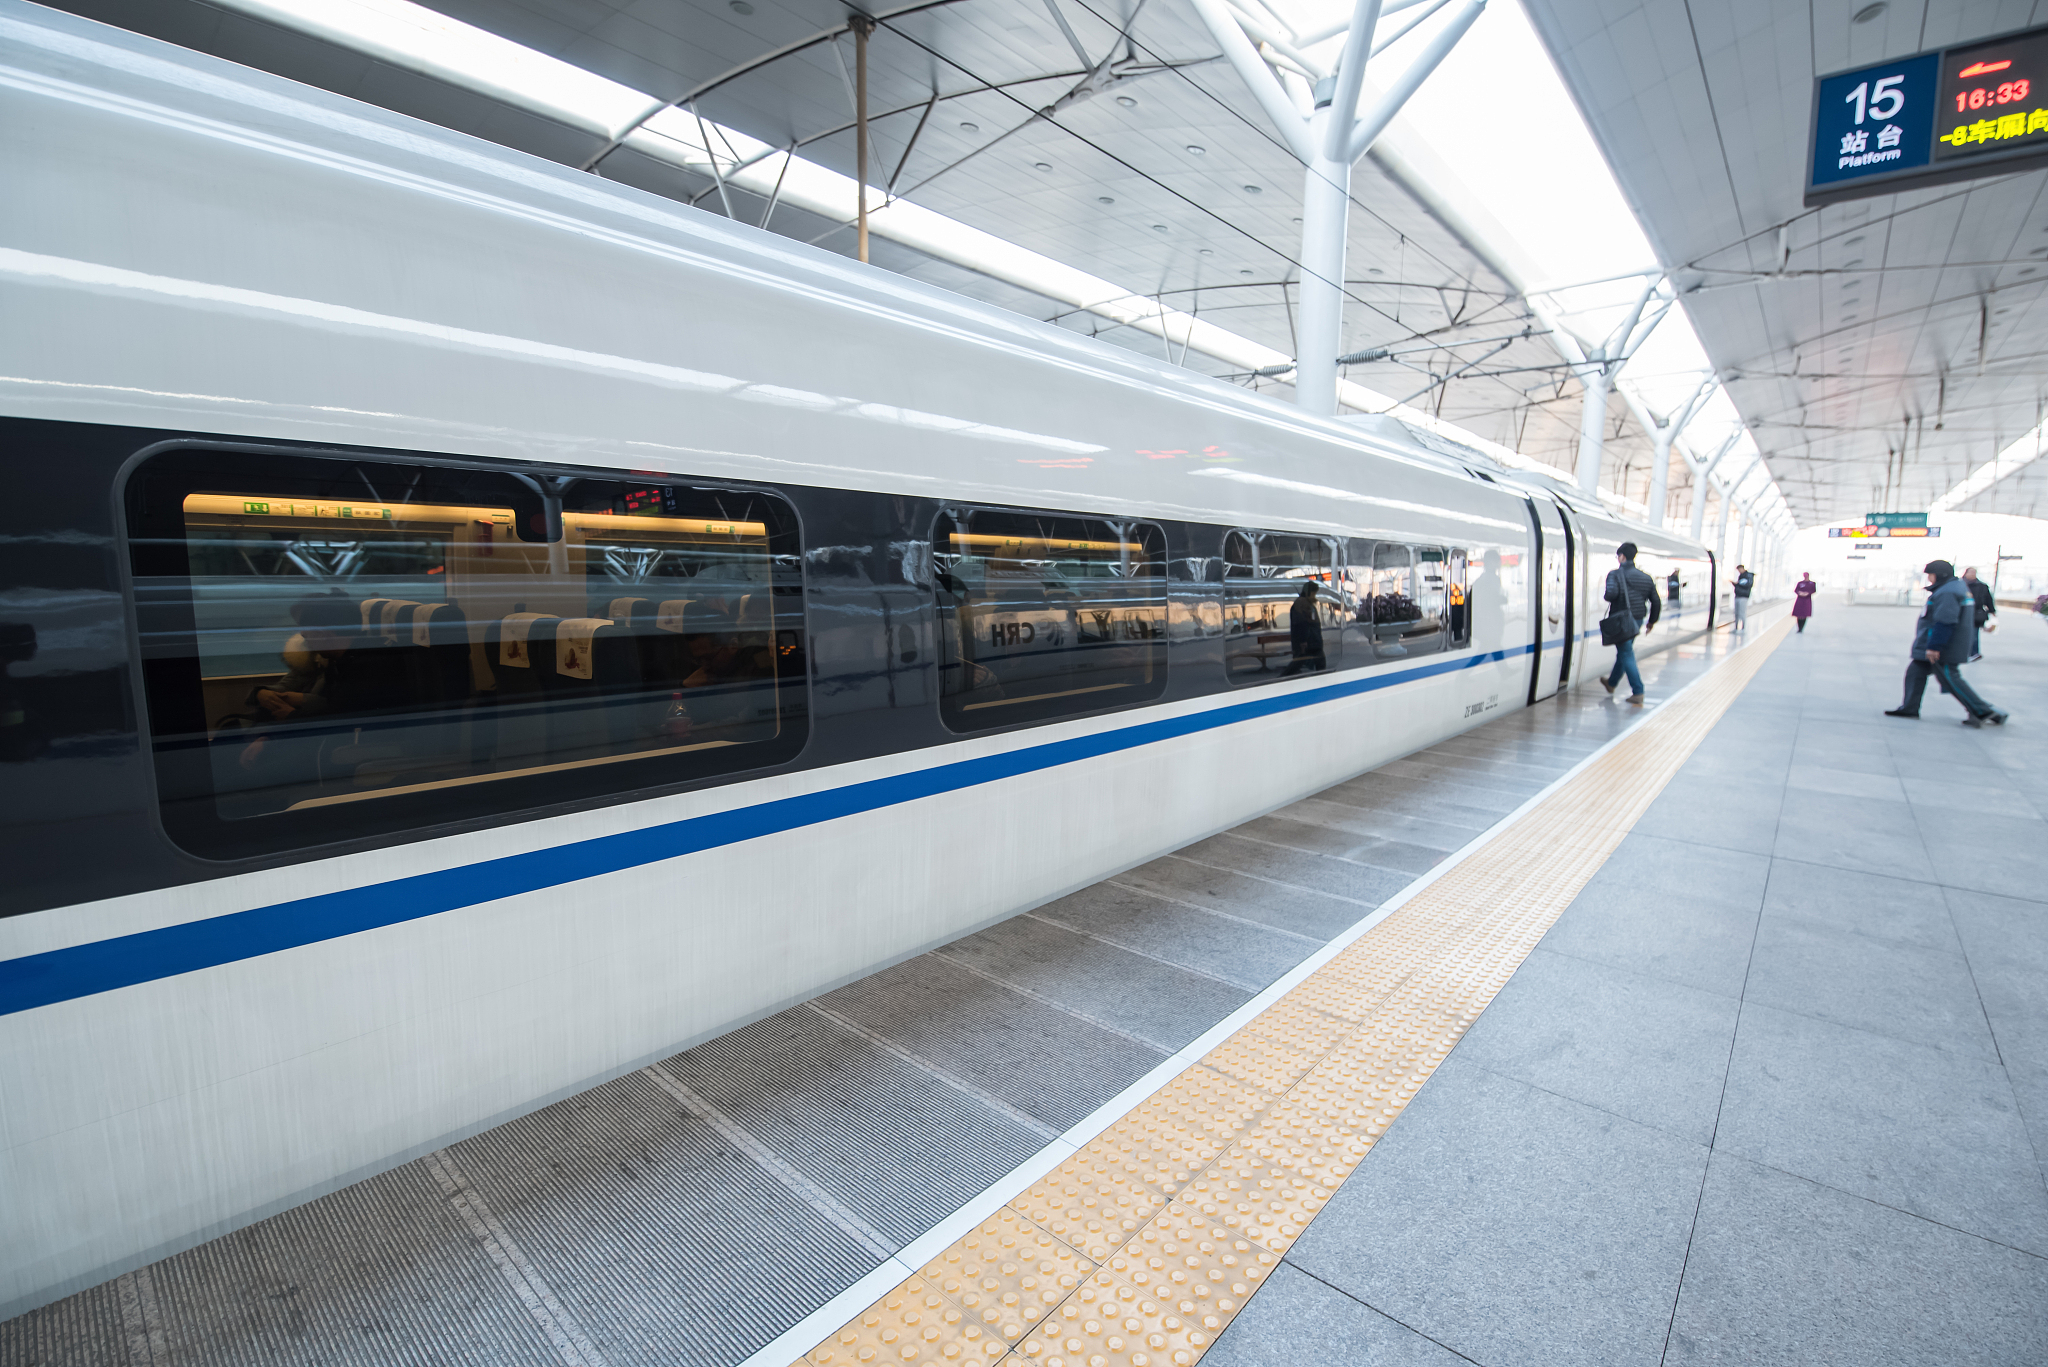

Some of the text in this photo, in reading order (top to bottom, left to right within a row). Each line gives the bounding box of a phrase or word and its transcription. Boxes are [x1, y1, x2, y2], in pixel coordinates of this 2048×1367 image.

[1845, 75, 1905, 124] 15
[1956, 79, 2029, 112] 16:33
[1839, 124, 1903, 155] 站台
[1838, 149, 1901, 170] Platform
